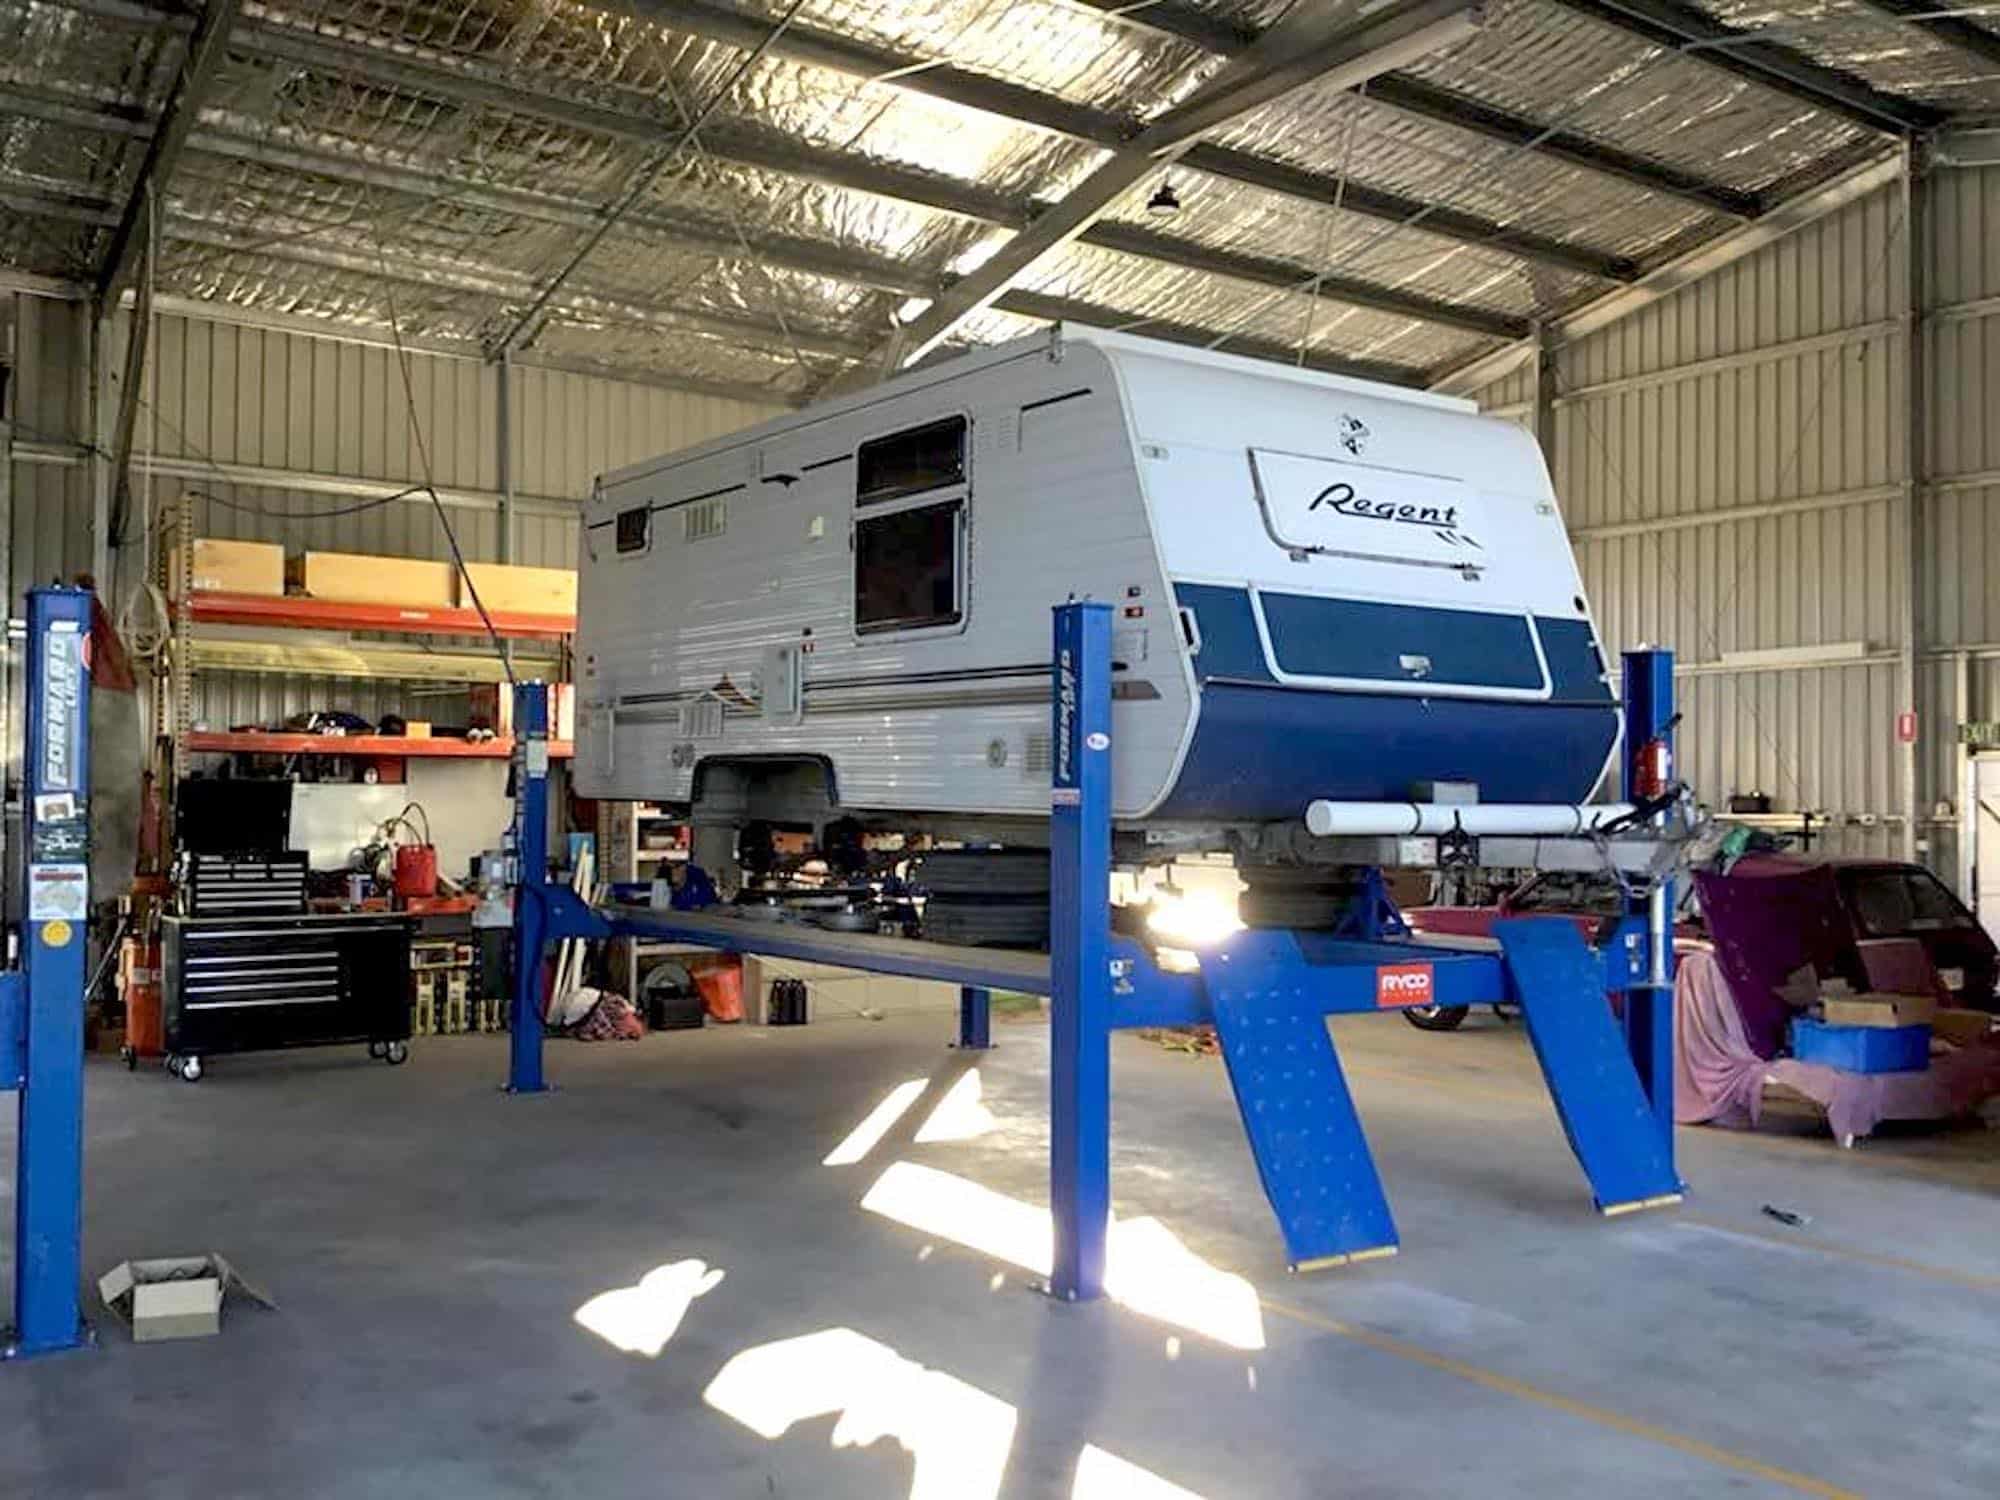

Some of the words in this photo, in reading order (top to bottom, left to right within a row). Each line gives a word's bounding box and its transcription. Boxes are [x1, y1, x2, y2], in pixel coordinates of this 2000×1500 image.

[1309, 482, 1458, 529] Regent
[48, 633, 67, 786] FORWARD
[1059, 650, 1070, 781] FORWARD
[1382, 973, 1430, 991] RYCO
